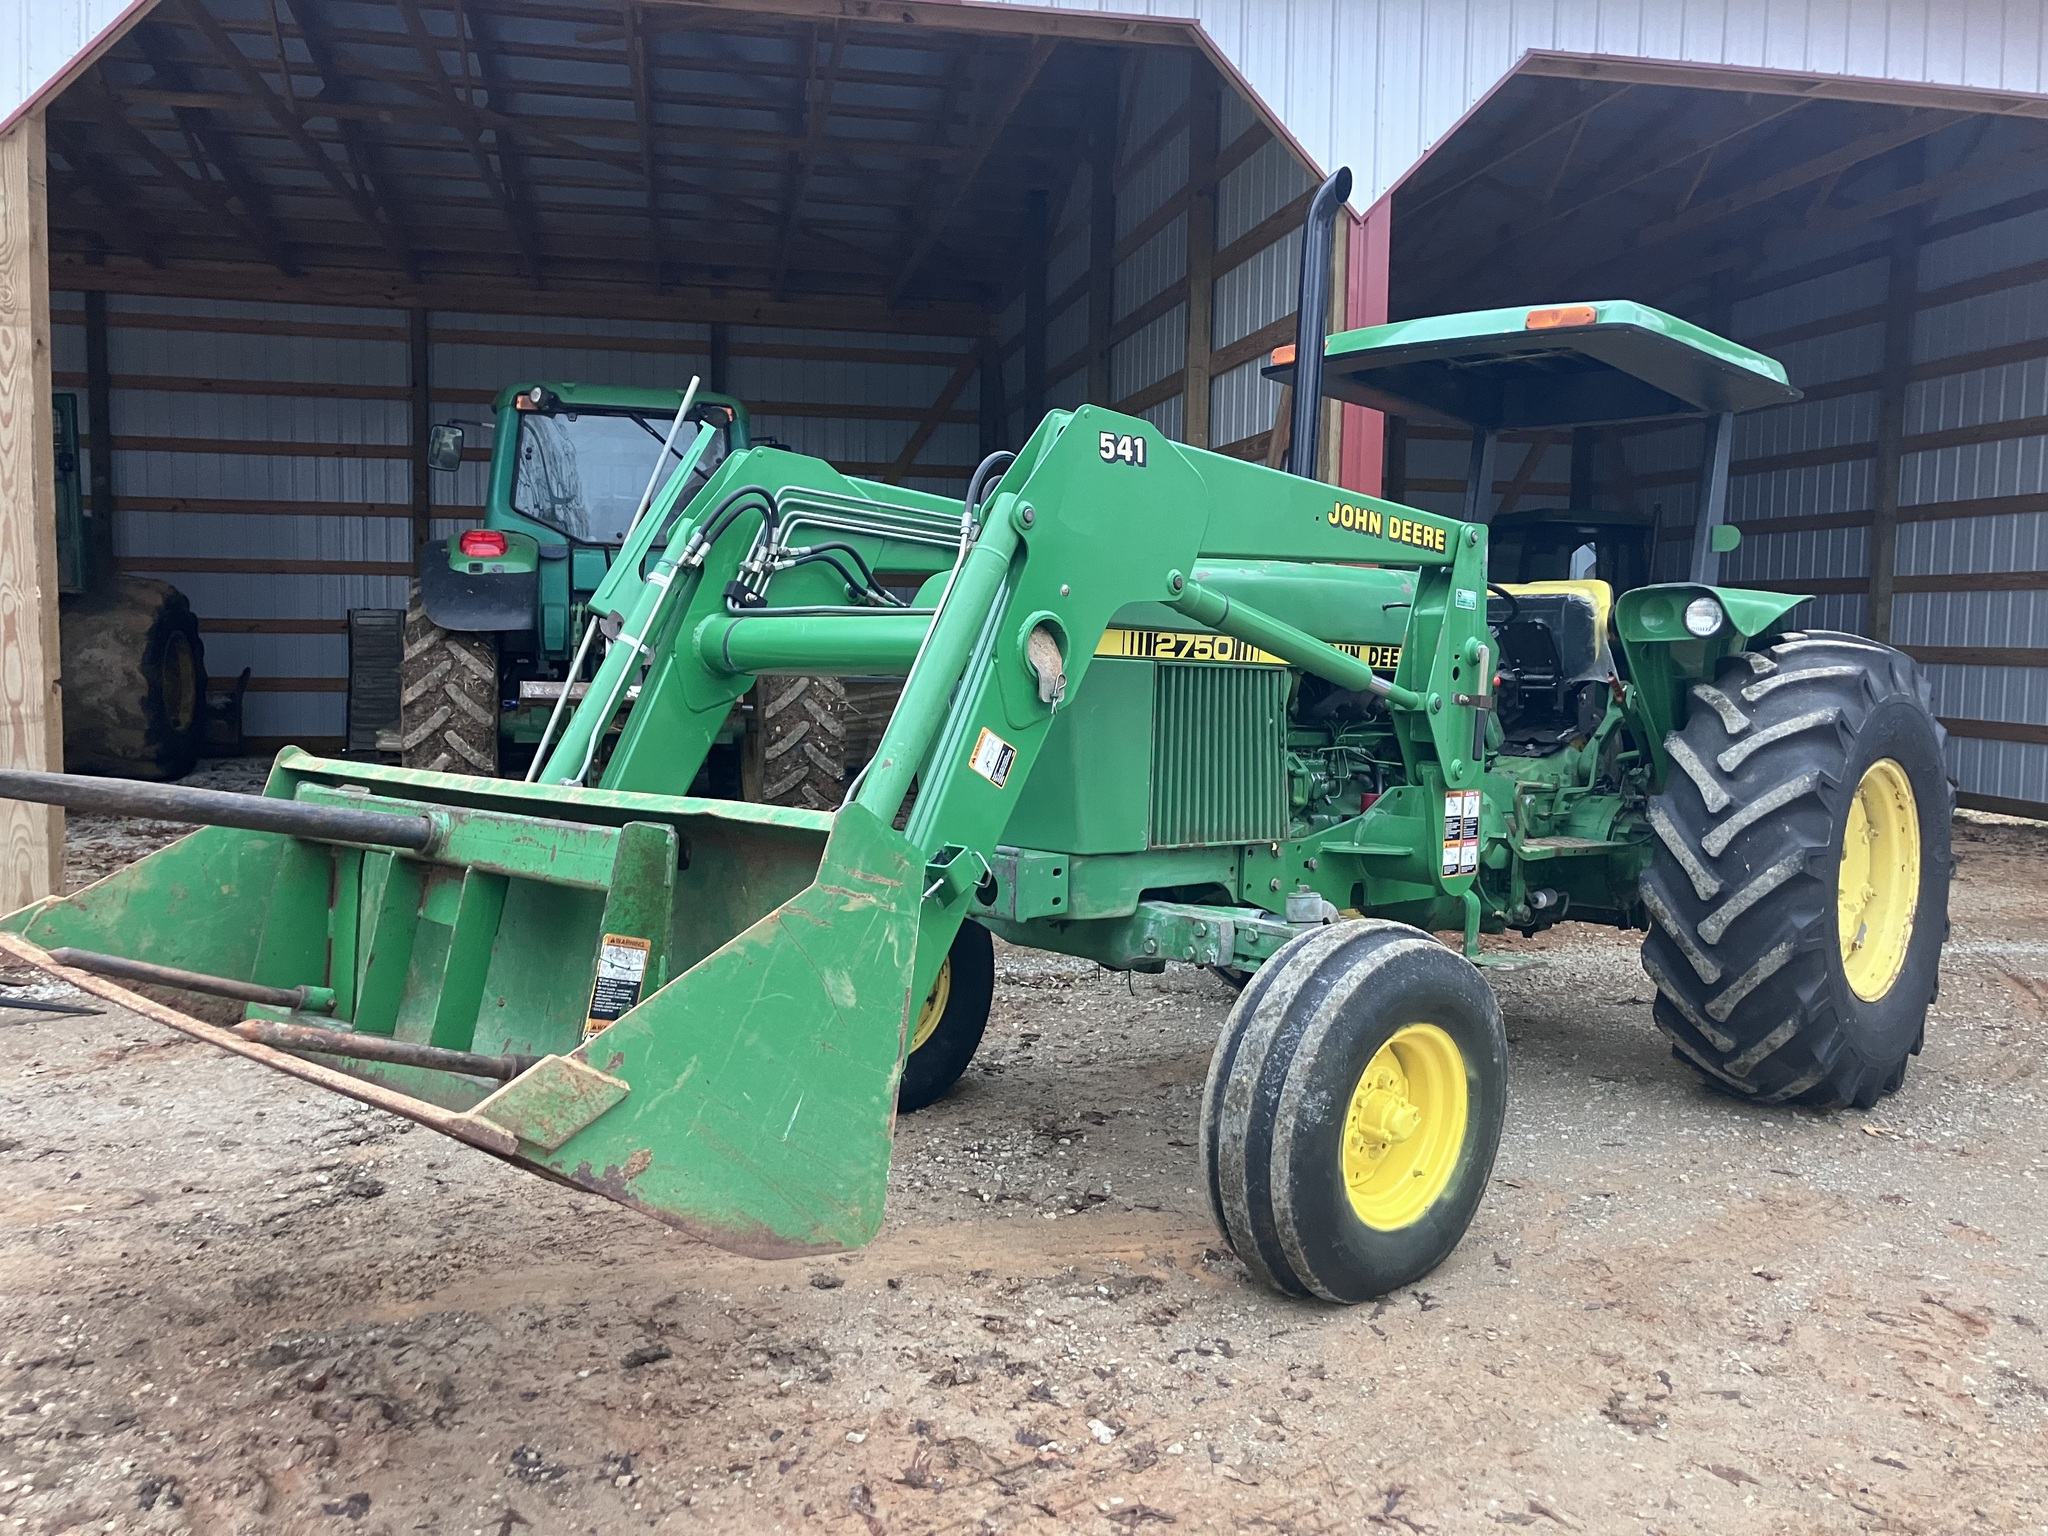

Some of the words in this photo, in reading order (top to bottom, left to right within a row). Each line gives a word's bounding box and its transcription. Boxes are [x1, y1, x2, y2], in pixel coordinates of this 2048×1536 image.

[1099, 431, 1147, 468] 541
[1327, 501, 1382, 539] JOHN
[1388, 515, 1446, 554] DEERE
[1155, 632, 1233, 661] 2750
[1368, 646, 1400, 667] DEE
[615, 937, 645, 948] WARNING
